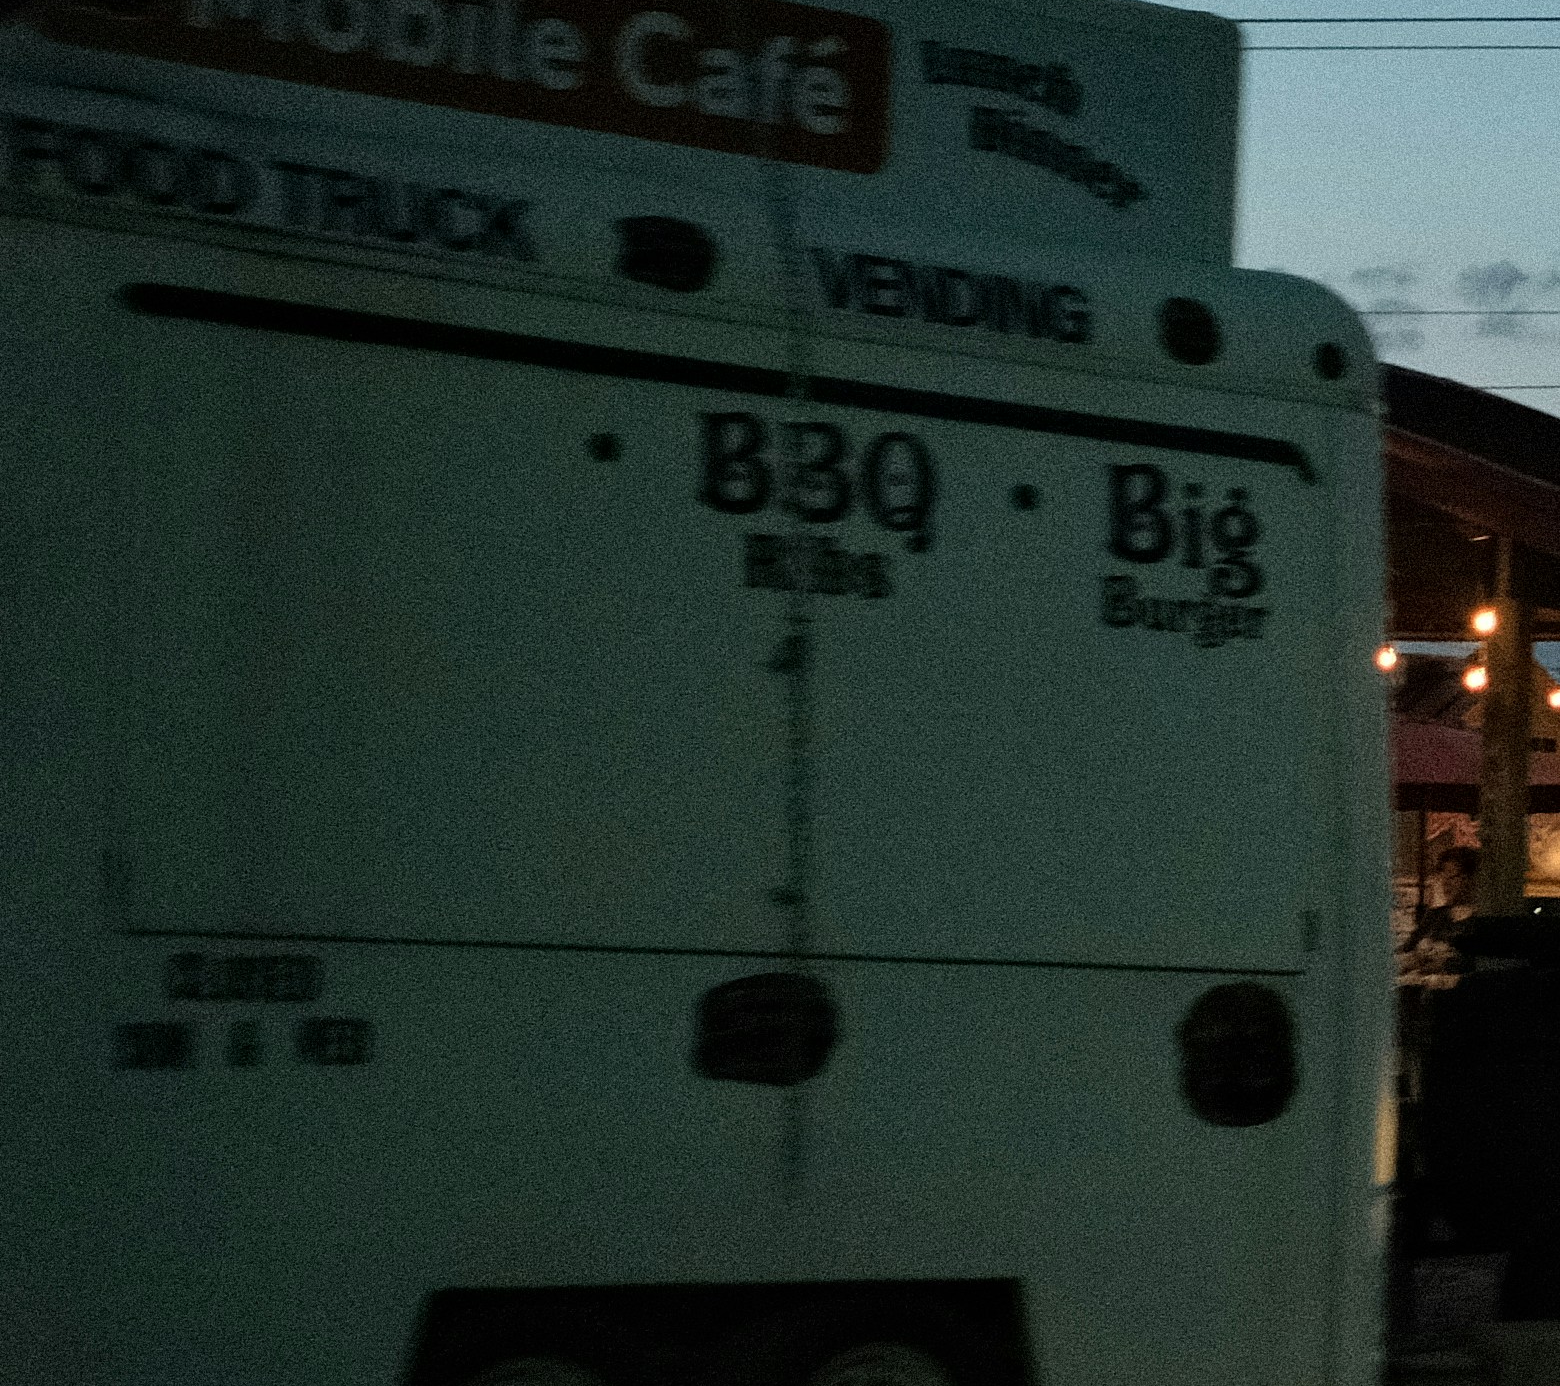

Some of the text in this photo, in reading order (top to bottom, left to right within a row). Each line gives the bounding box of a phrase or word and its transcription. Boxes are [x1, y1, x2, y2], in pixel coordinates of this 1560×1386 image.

[612, 6, 853, 136] Café
[14, 114, 535, 267] FOOD TRUCK
[810, 243, 1092, 348] VENDING
[696, 409, 940, 555] BBQ
[1104, 461, 1268, 599] Big
[1100, 572, 1270, 649] Burger
